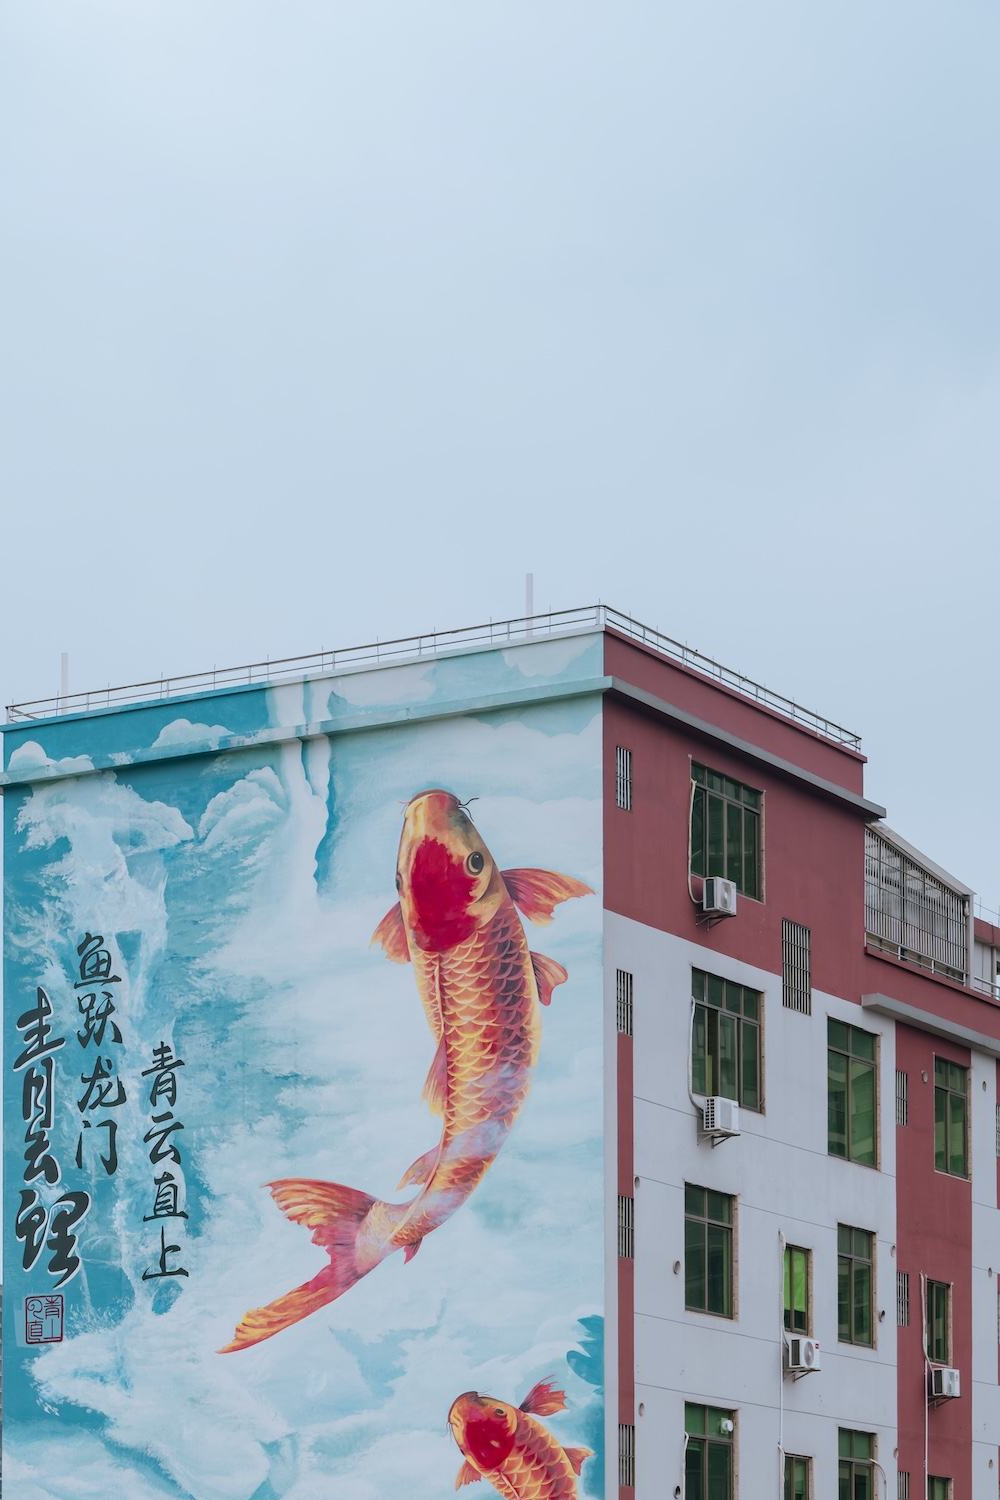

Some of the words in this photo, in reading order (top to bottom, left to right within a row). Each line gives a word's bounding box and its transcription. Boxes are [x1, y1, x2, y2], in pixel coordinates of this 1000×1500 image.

[74, 932, 127, 1176] 鱼跃龙门
[142, 1041, 189, 1281] 青云直上
